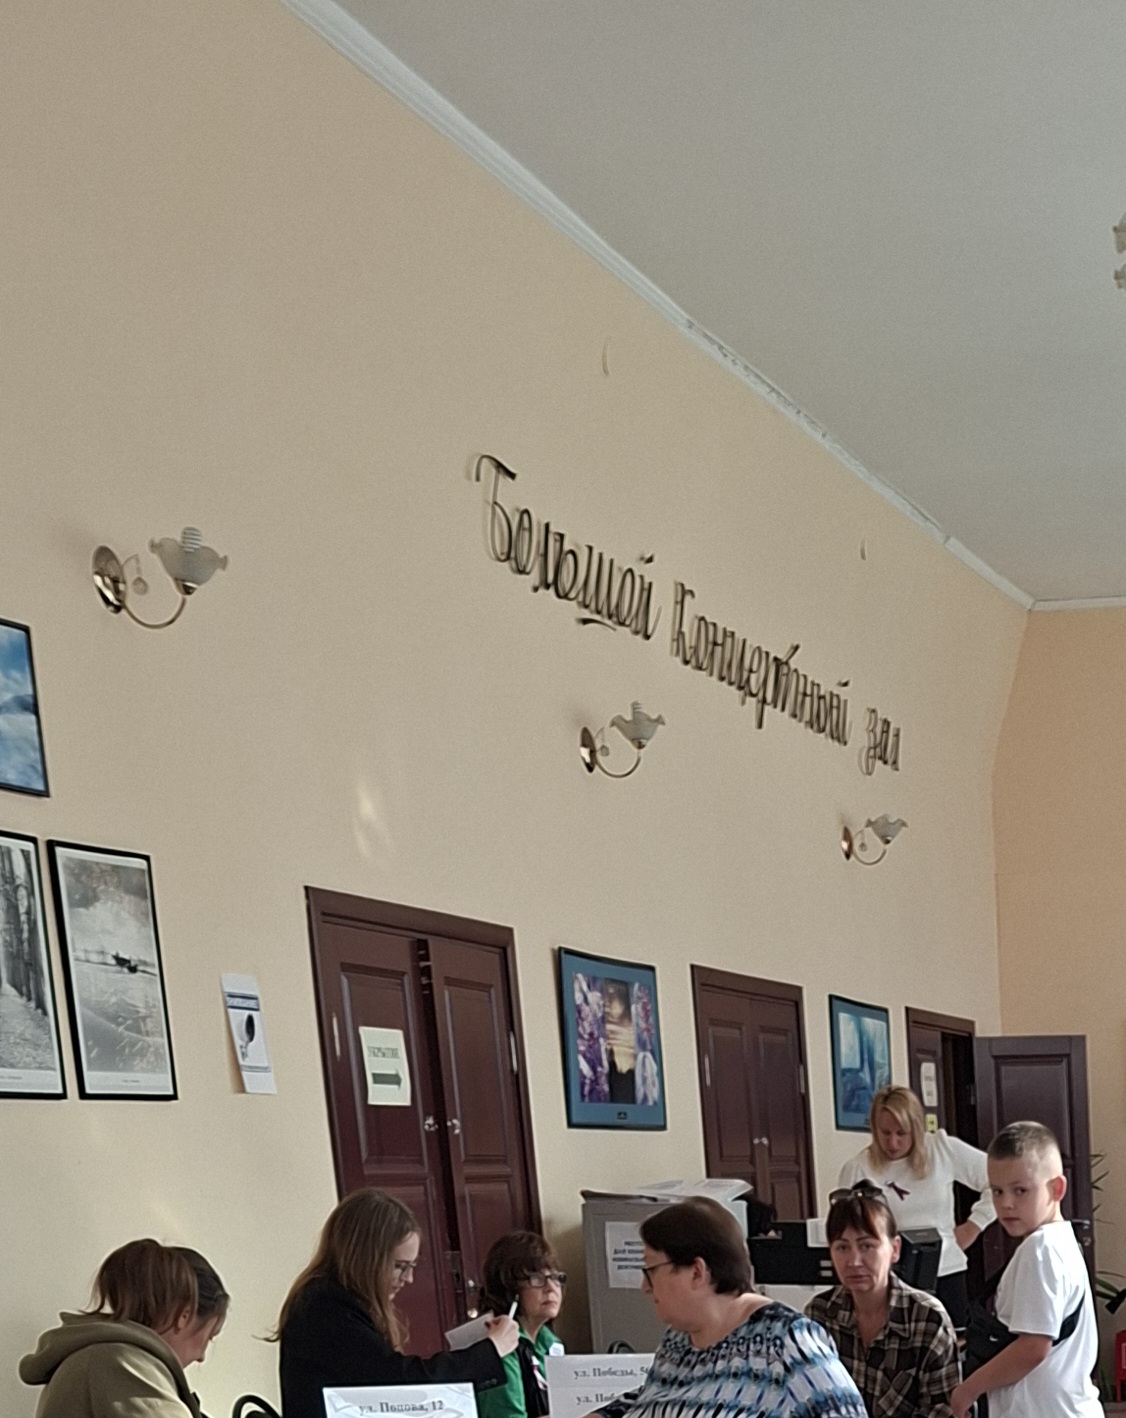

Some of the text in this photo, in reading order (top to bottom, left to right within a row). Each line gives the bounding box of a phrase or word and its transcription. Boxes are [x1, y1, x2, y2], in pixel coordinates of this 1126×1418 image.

[474, 454, 661, 641] Большой
[573, 1370, 590, 1380] ул.
[359, 1400, 445, 1416] ул. Попова, 12
